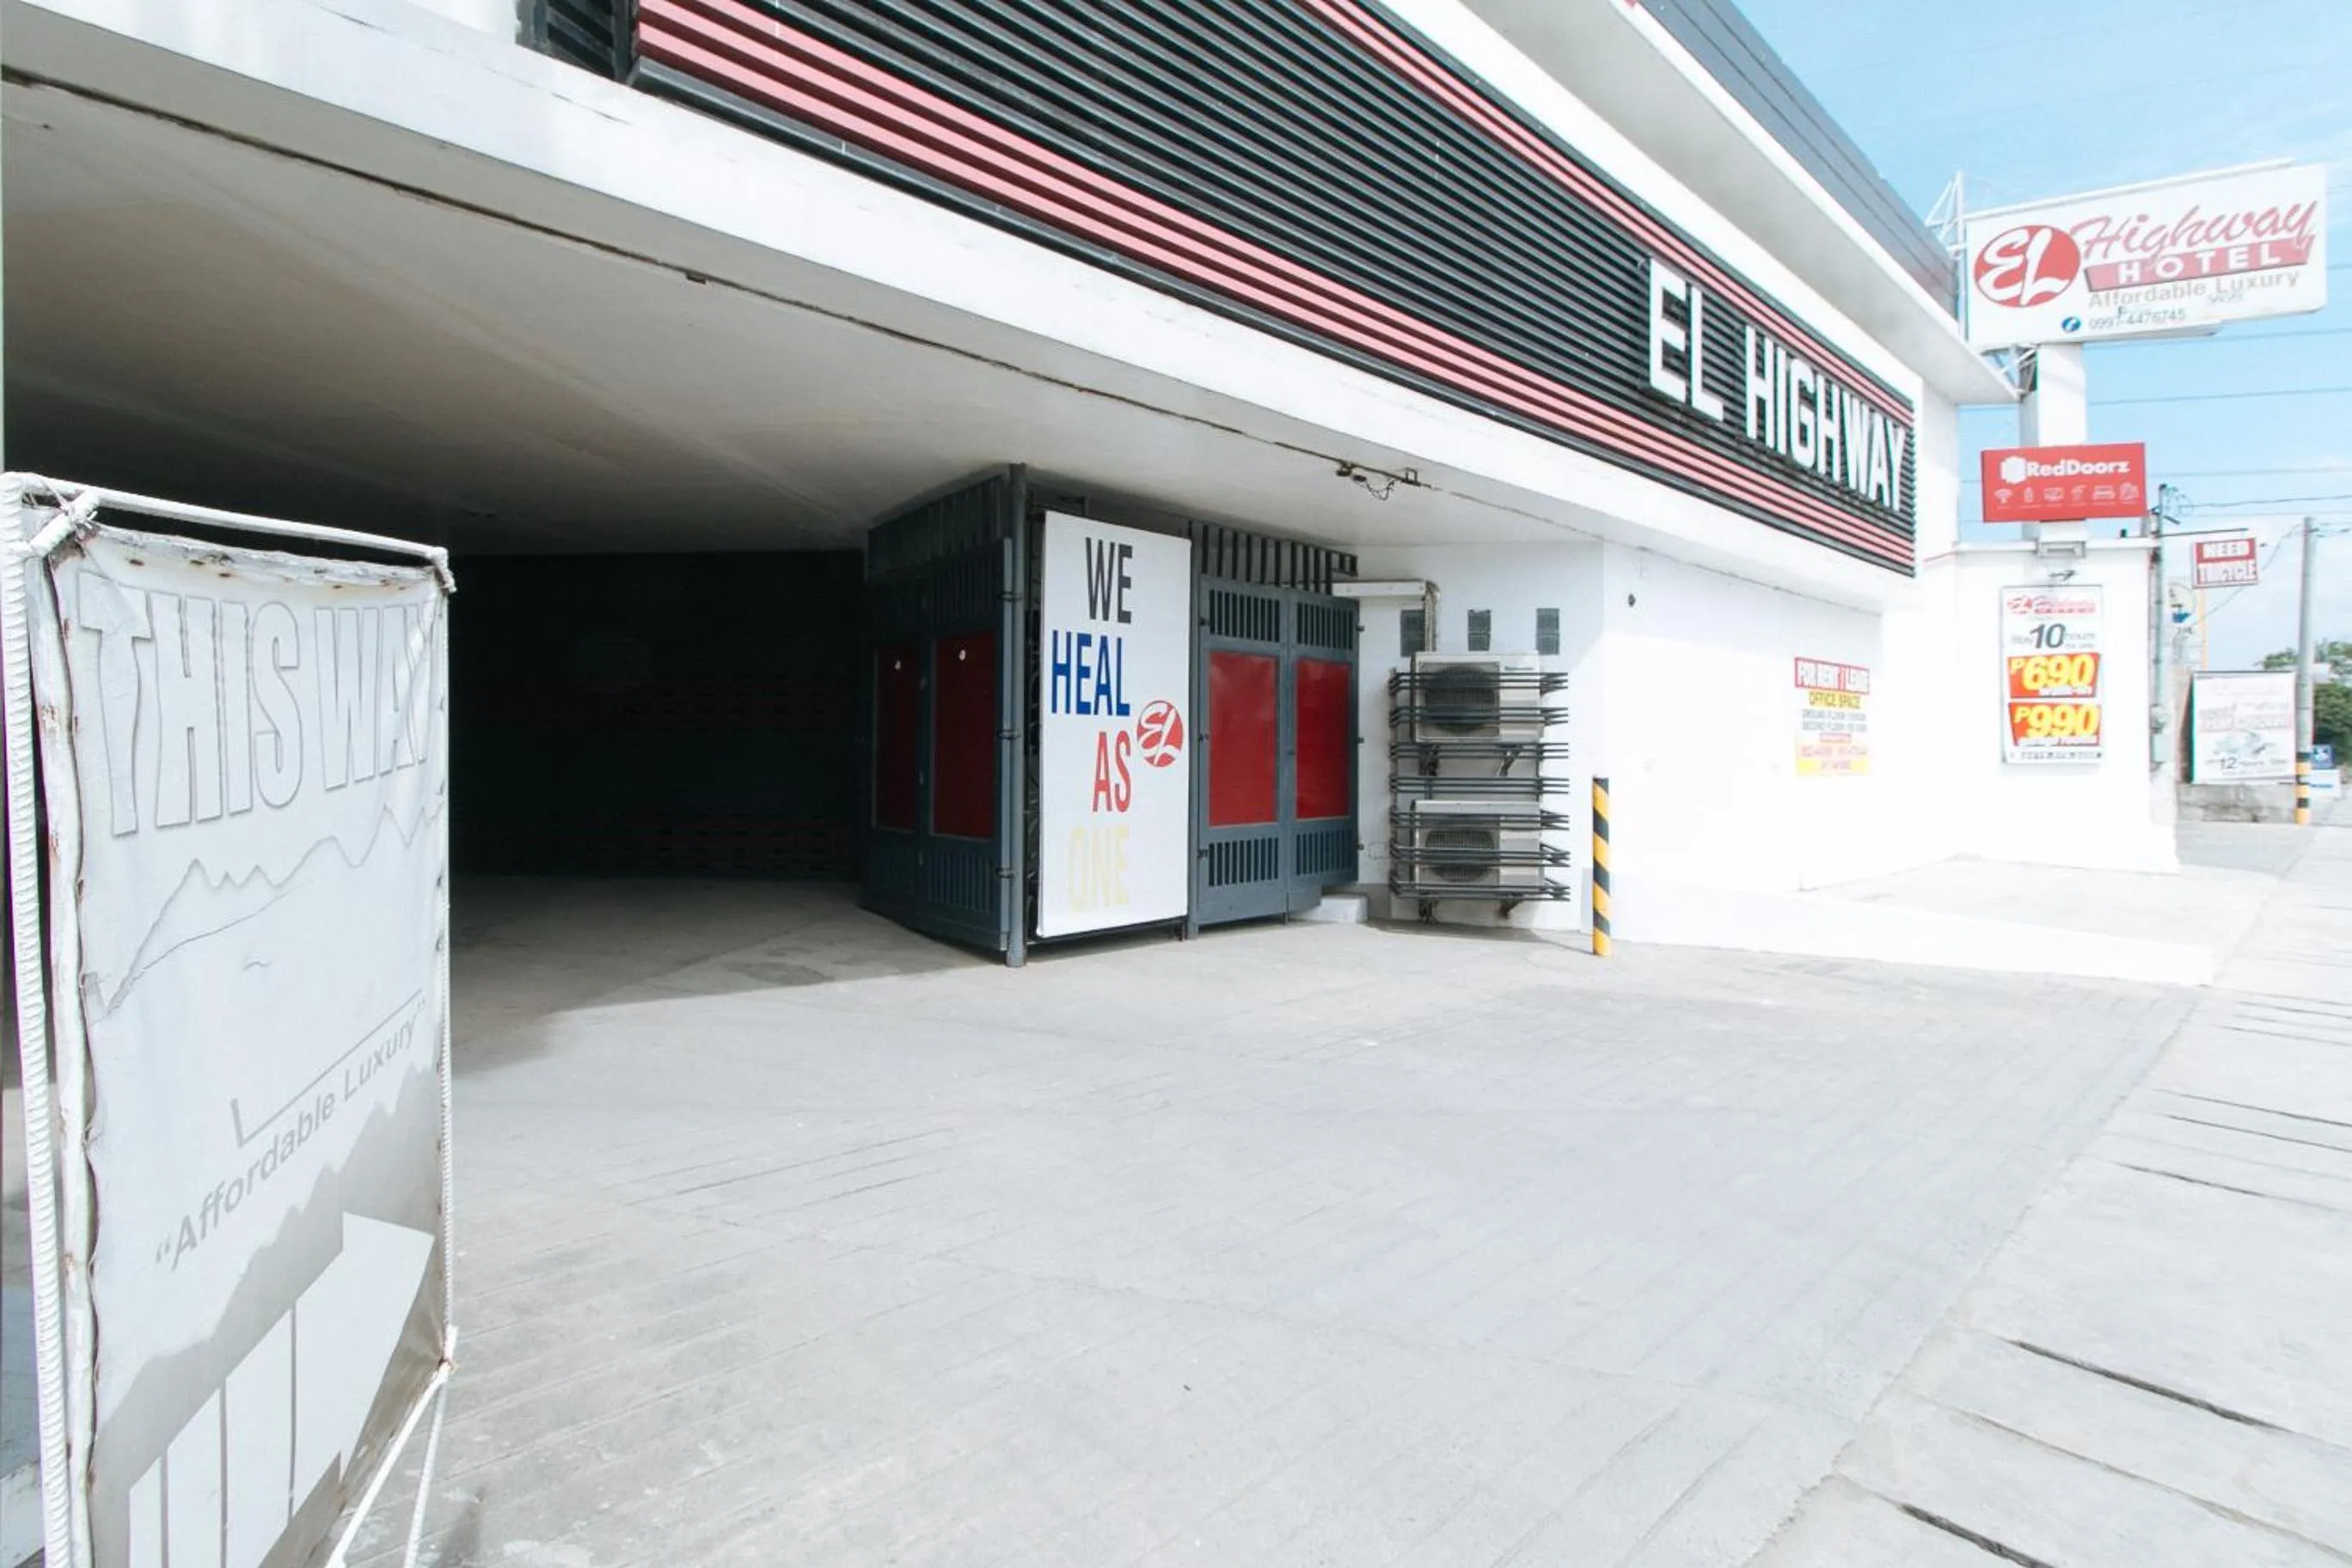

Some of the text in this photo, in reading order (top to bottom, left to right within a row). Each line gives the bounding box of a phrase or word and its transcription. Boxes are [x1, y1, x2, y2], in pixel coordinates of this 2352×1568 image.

[1979, 226, 2075, 307] EL
[2070, 200, 2318, 260] Highway
[2117, 242, 2282, 284] HOTEL
[2087, 282, 2207, 309] Affordable
[2215, 270, 2300, 294] Luxury
[1649, 257, 1906, 513] EL HIGHWAY
[2026, 458, 2131, 477] RedDoorz
[1085, 536, 1133, 623] WE
[1050, 629, 1130, 717] HEAL
[2030, 623, 2066, 648] 10
[78, 571, 303, 837] THIS
[1092, 729, 1131, 813] AS
[1068, 823, 1130, 913] ONE
